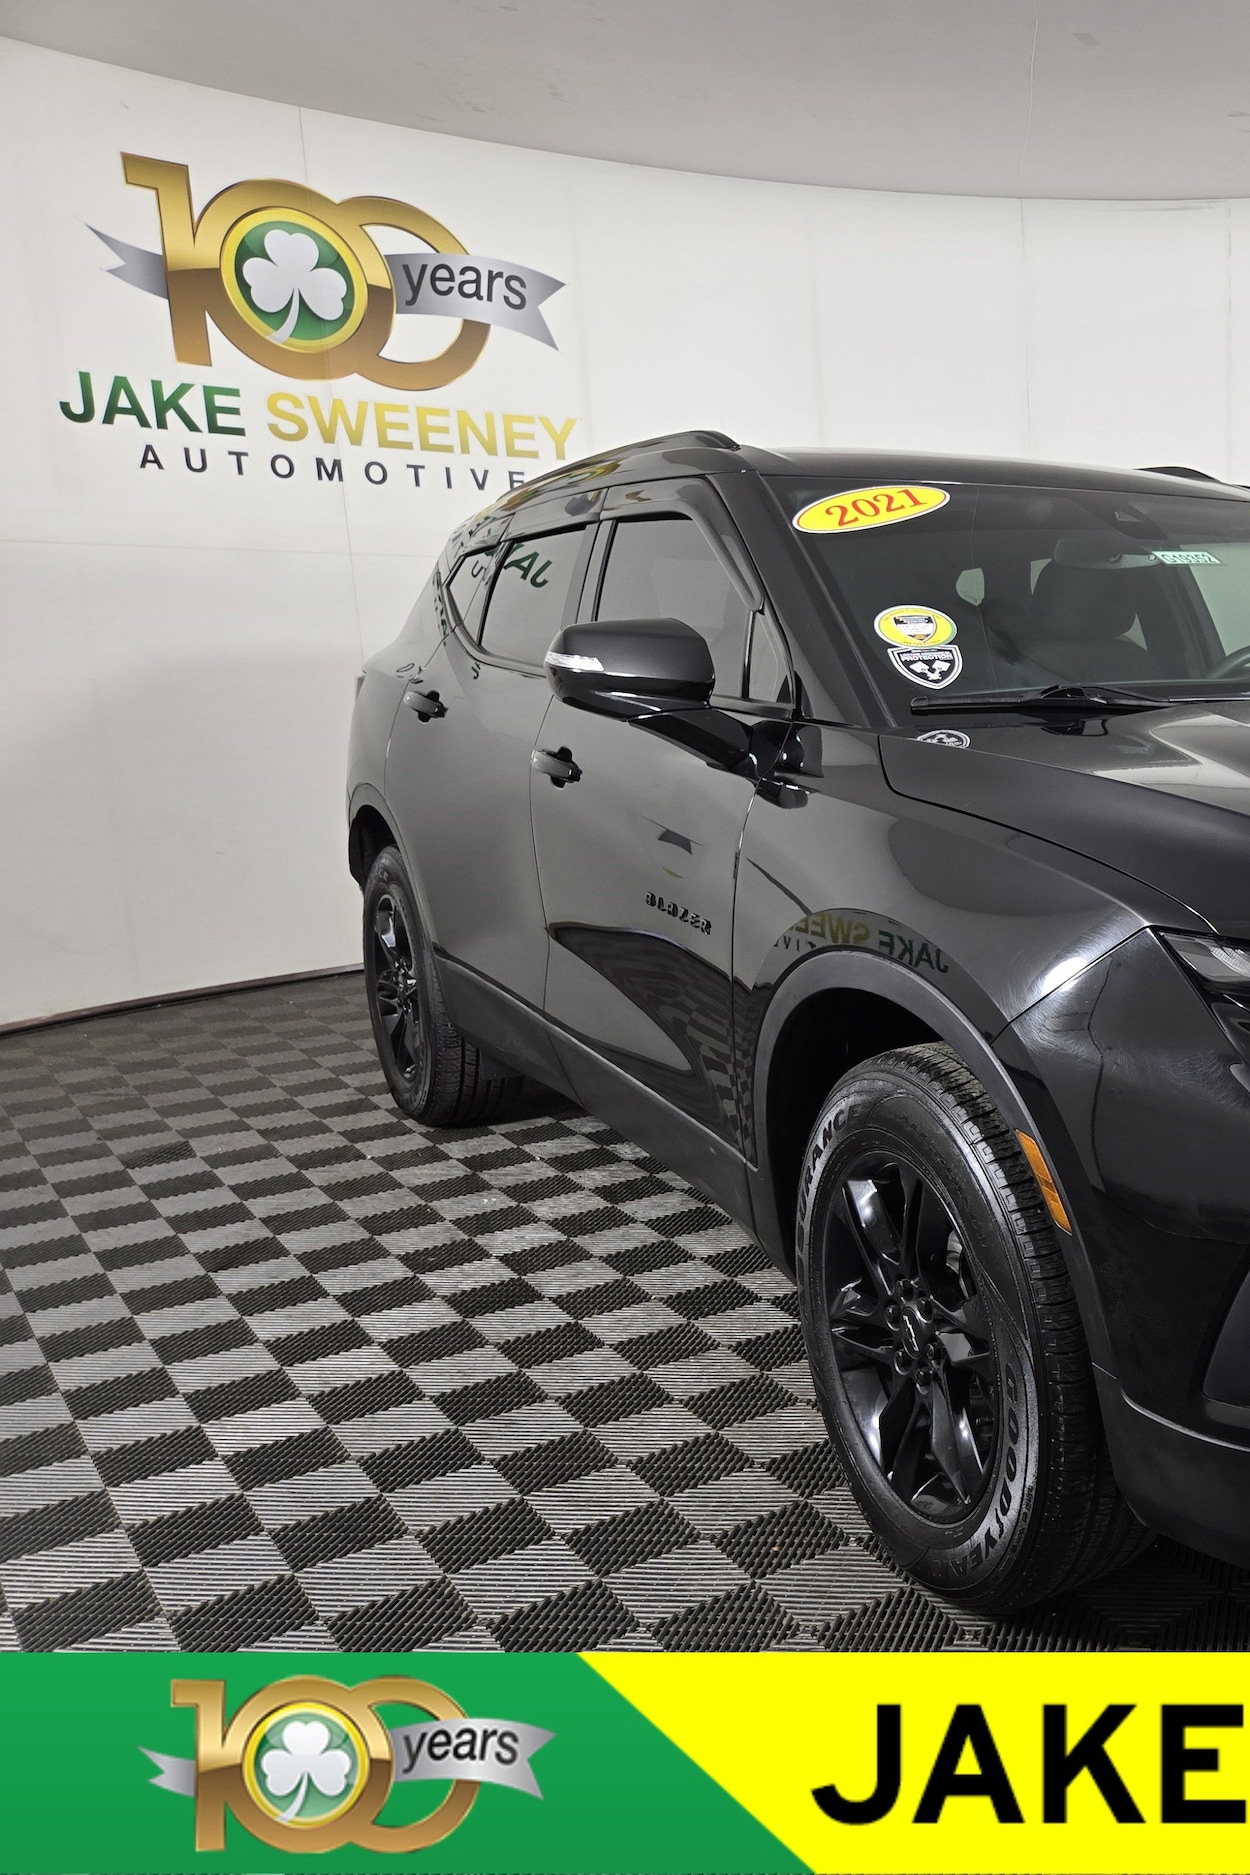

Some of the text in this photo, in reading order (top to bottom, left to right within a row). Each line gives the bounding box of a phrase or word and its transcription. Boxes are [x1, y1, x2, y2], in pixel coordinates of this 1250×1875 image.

[402, 262, 528, 310] years
[59, 370, 579, 461] JAKE SWEENEY
[139, 443, 525, 492] AUTOMOTIVE
[825, 488, 927, 527] 2021
[645, 891, 712, 935] BLAZER
